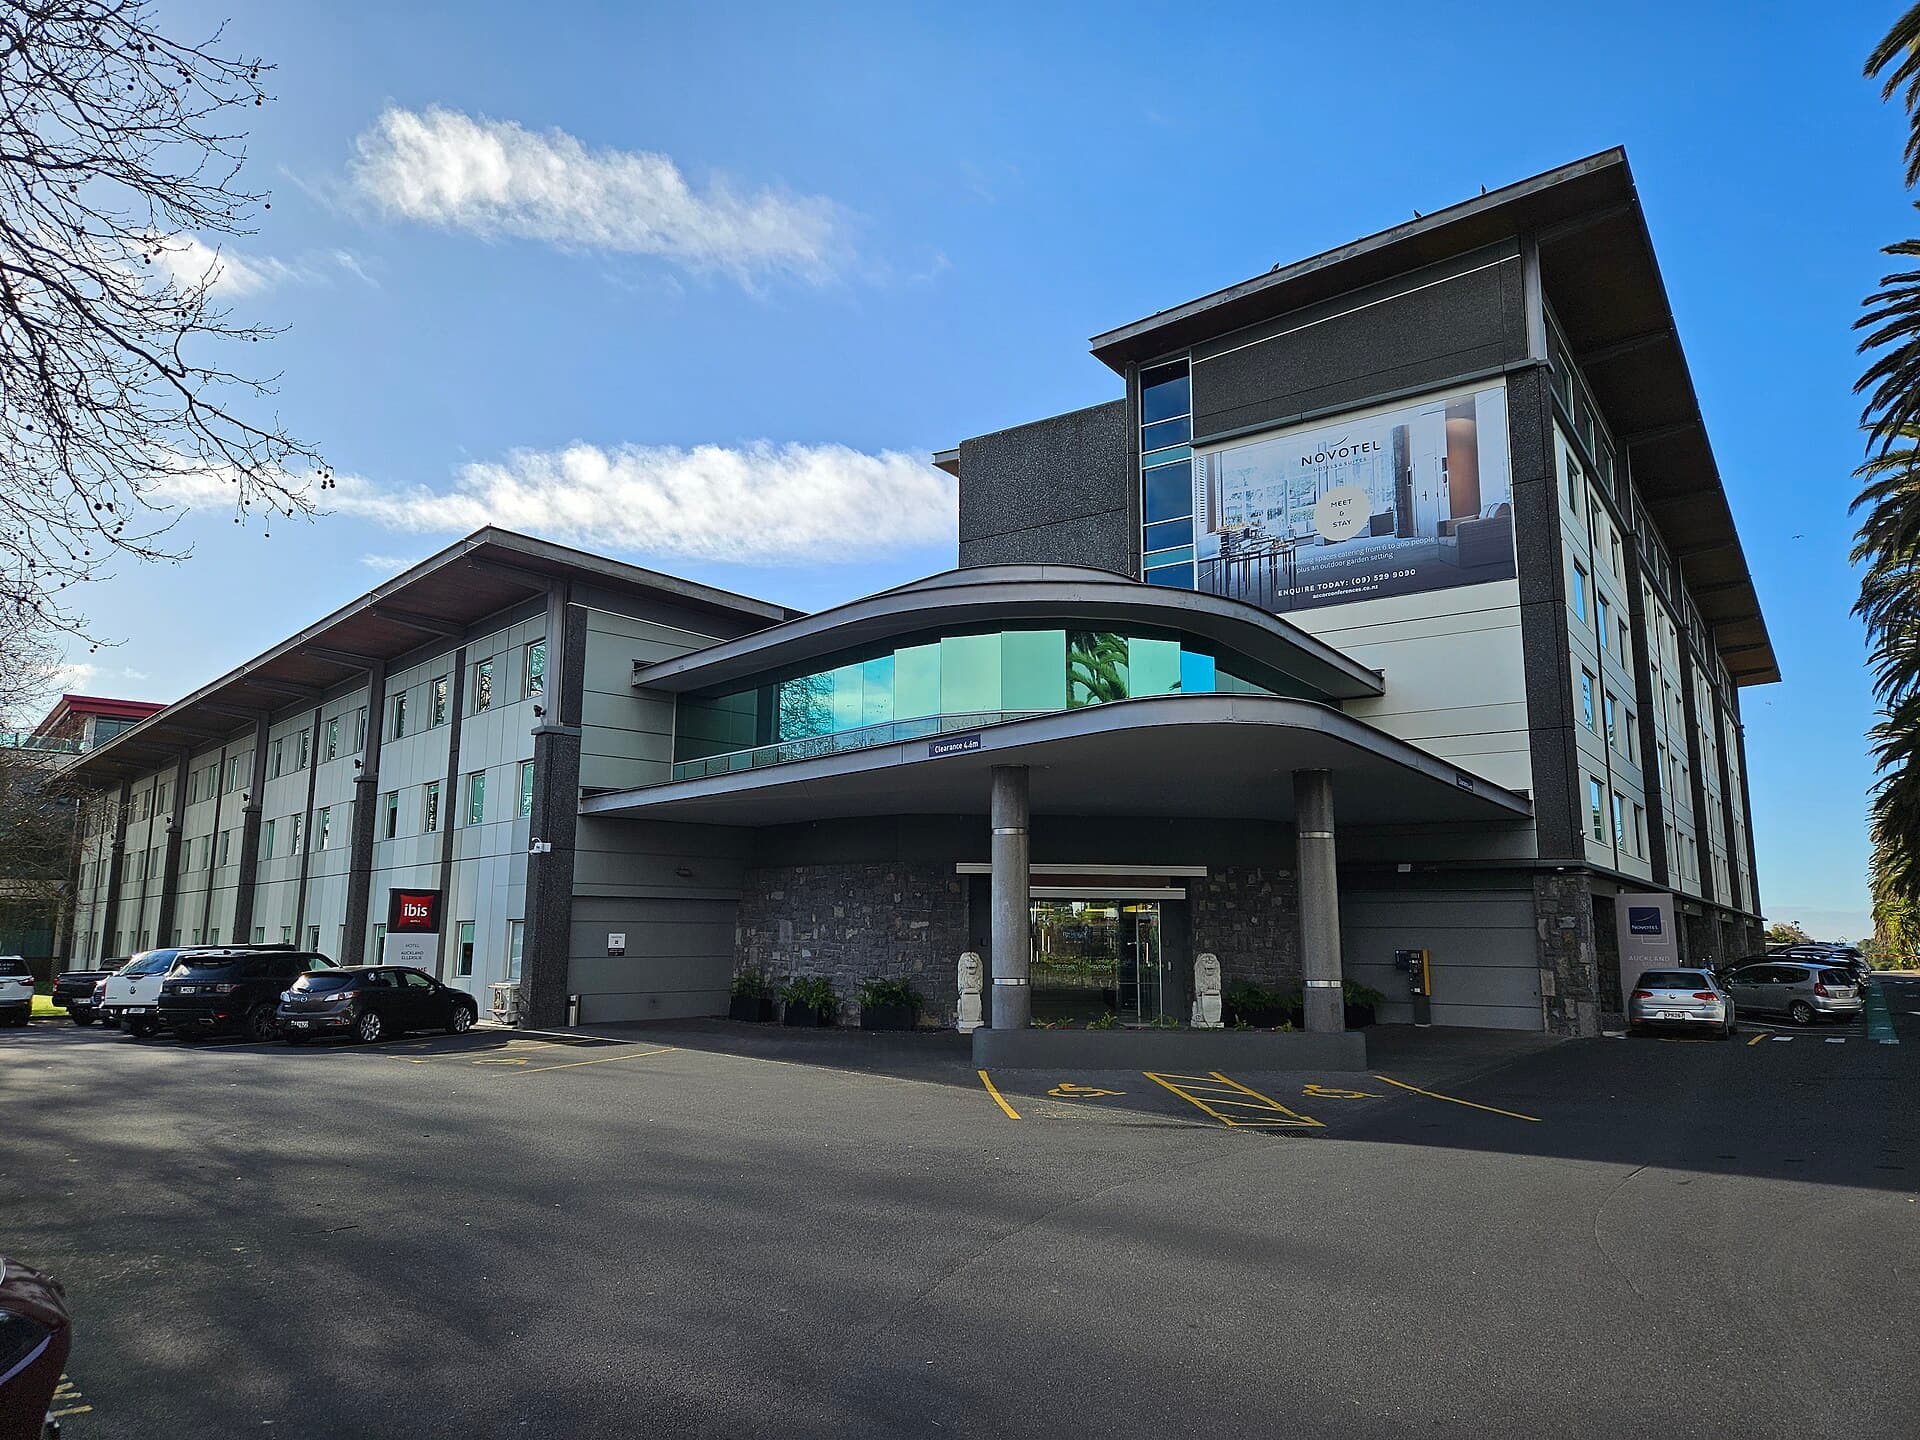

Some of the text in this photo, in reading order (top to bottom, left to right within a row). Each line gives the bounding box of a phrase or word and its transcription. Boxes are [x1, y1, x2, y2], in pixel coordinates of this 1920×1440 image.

[1301, 440, 1381, 467] NOVOTEL
[1330, 498, 1352, 508] MEET
[1332, 519, 1352, 528] STAY
[1315, 553, 1337, 563] spaces
[1338, 549, 1365, 559] catering
[1365, 545, 1382, 553] from
[1411, 536, 1435, 547] people
[1296, 566, 1310, 574] plus
[1320, 561, 1345, 570] outdoor
[1346, 556, 1370, 567] garden
[1371, 552, 1394, 561] setting
[1278, 568, 1416, 597] ENQUIRE TODAY: (09) 529 9090
[1312, 584, 1379, 599] accorconferences.co.nz
[934, 740, 979, 754] Clearance 4.6m
[403, 903, 428, 917] ibis
[1629, 954, 1670, 962] AUCKLAND
